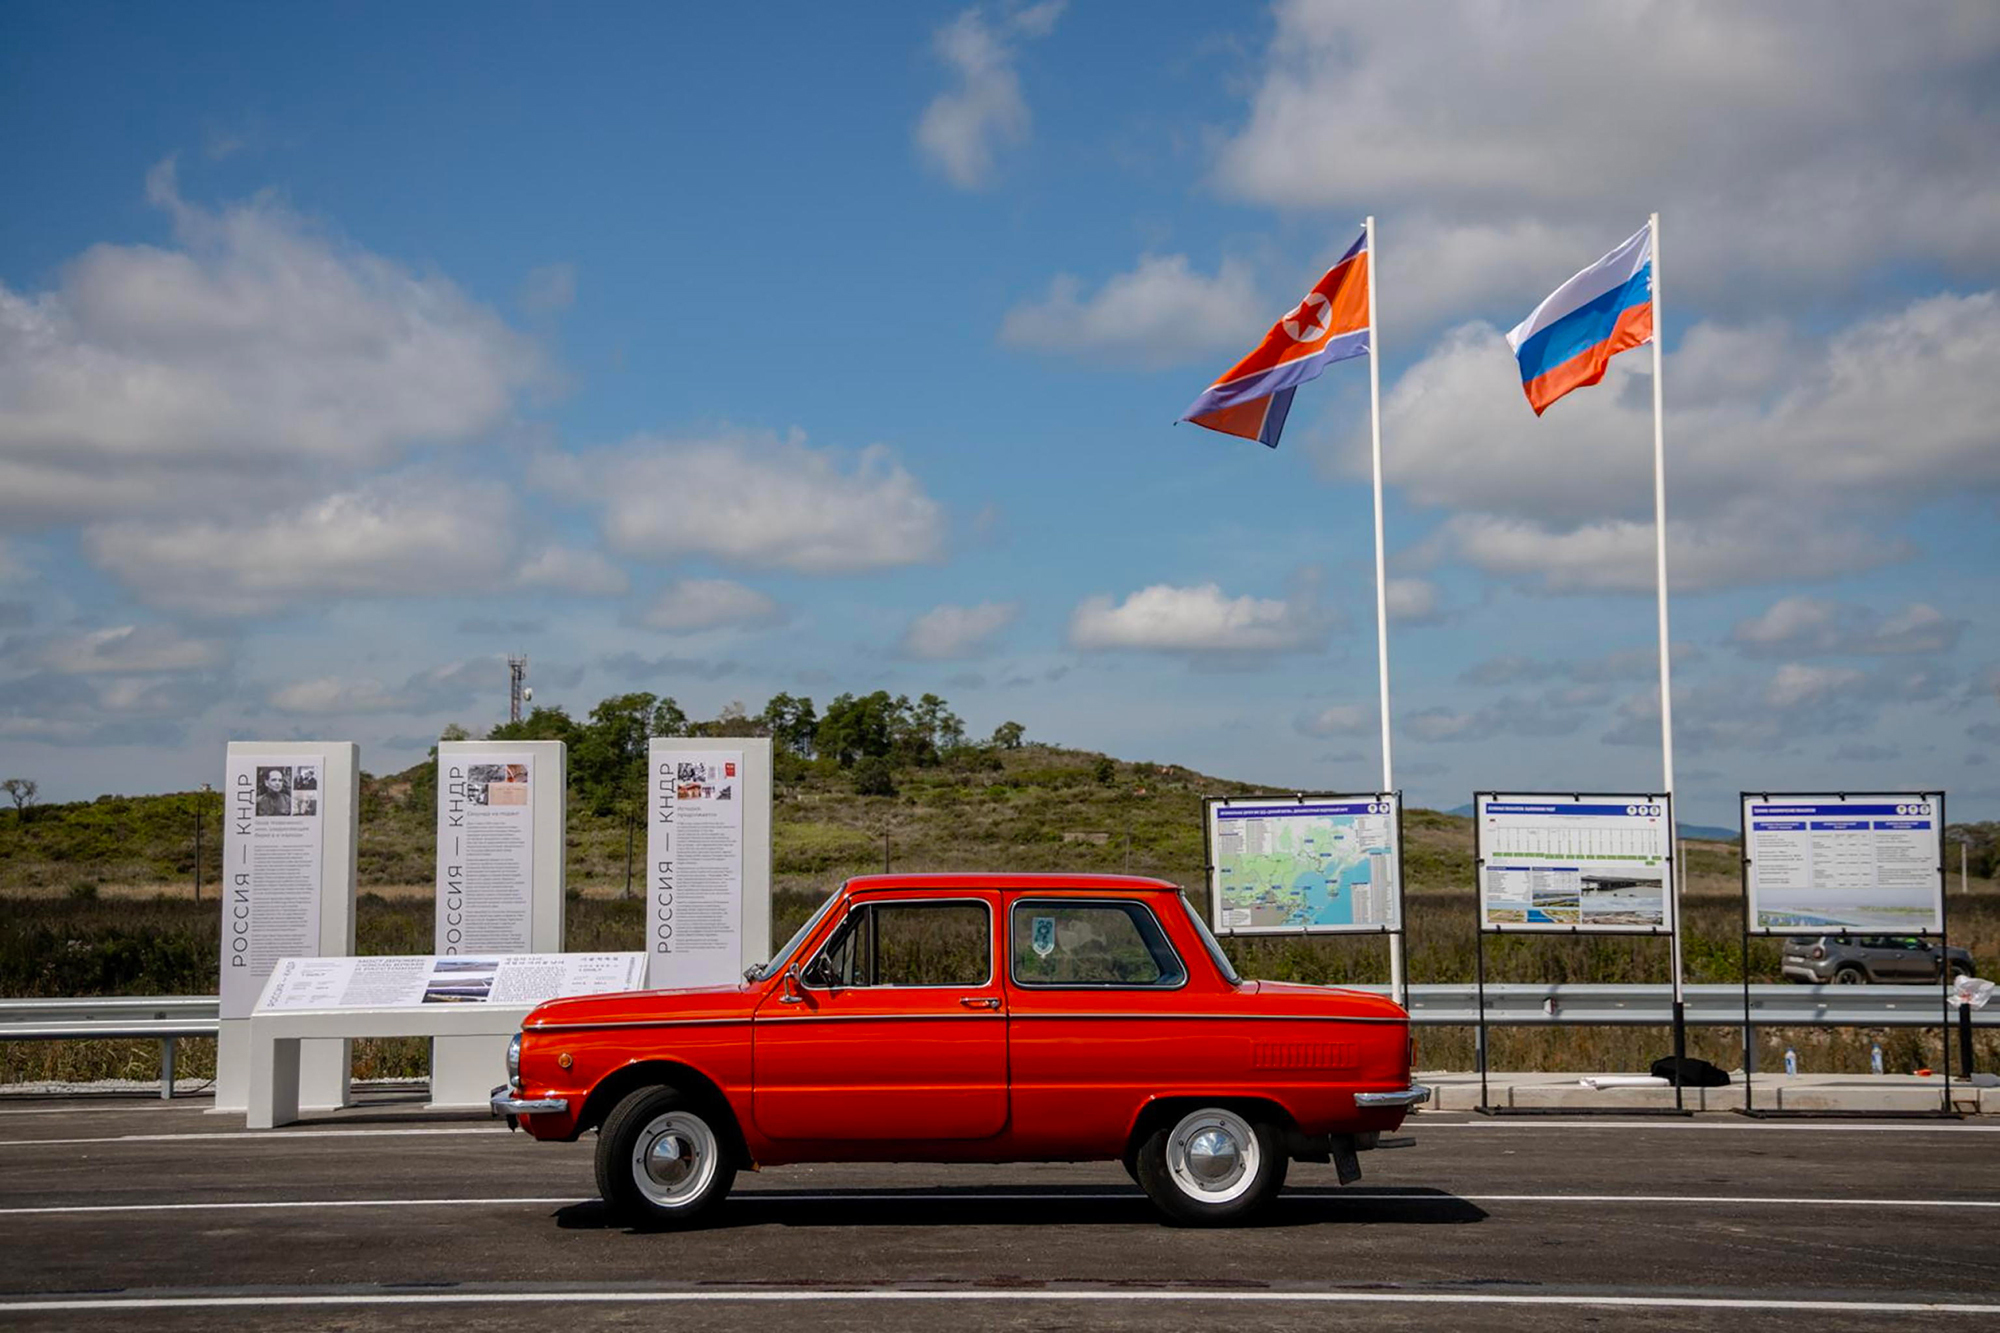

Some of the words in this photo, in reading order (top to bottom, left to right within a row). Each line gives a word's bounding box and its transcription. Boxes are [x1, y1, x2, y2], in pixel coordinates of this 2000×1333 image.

[236, 774, 255, 835] КНДР
[449, 766, 467, 827] КНДР
[659, 763, 676, 823] КНДР
[232, 873, 250, 967] РОССИЯ
[657, 861, 673, 954] РОССИЯ
